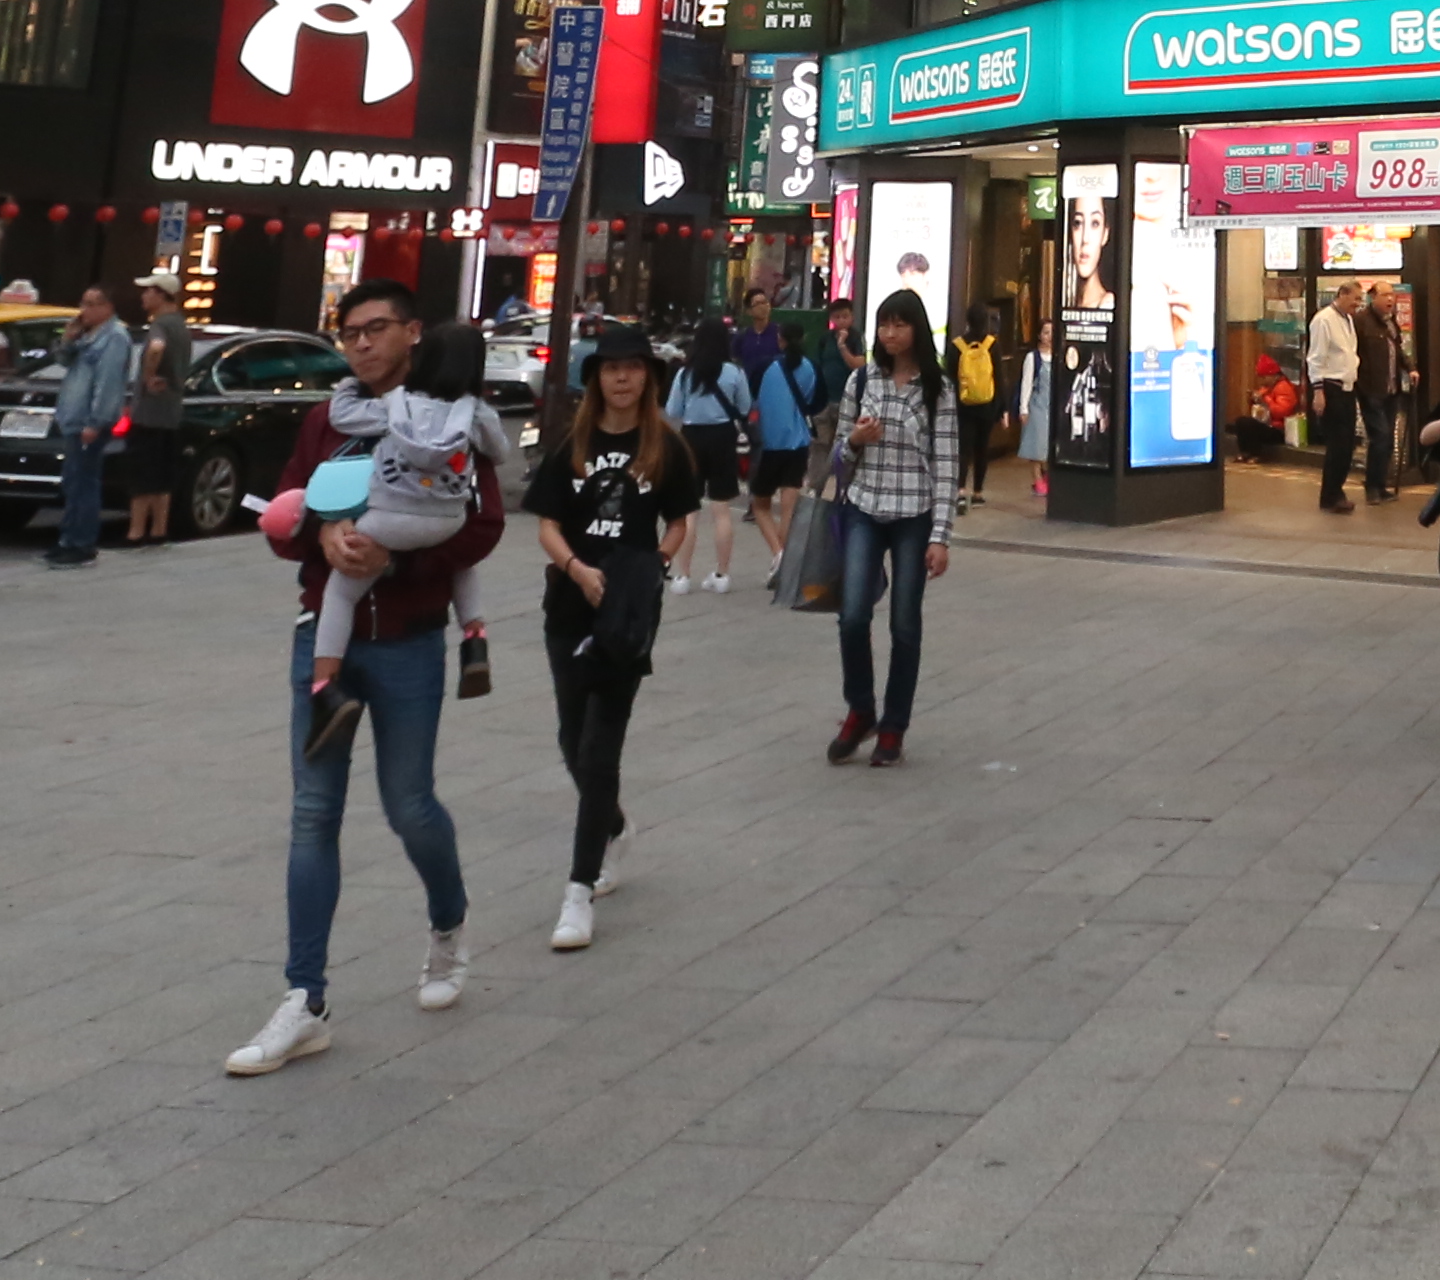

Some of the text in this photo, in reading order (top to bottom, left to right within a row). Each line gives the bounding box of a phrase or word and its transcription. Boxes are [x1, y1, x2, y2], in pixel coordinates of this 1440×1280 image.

[765, 13, 812, 29] 西門店
[1153, 18, 1360, 69] watsons
[549, 10, 577, 130] 中醫院區
[899, 47, 1018, 104] watsons 屈臣氏
[151, 139, 294, 185] UNDER
[298, 149, 454, 192] ARMOUR
[1228, 144, 1266, 157] watsons
[1223, 161, 1349, 195] 週三刷玉山卡
[585, 518, 625, 538] APE
